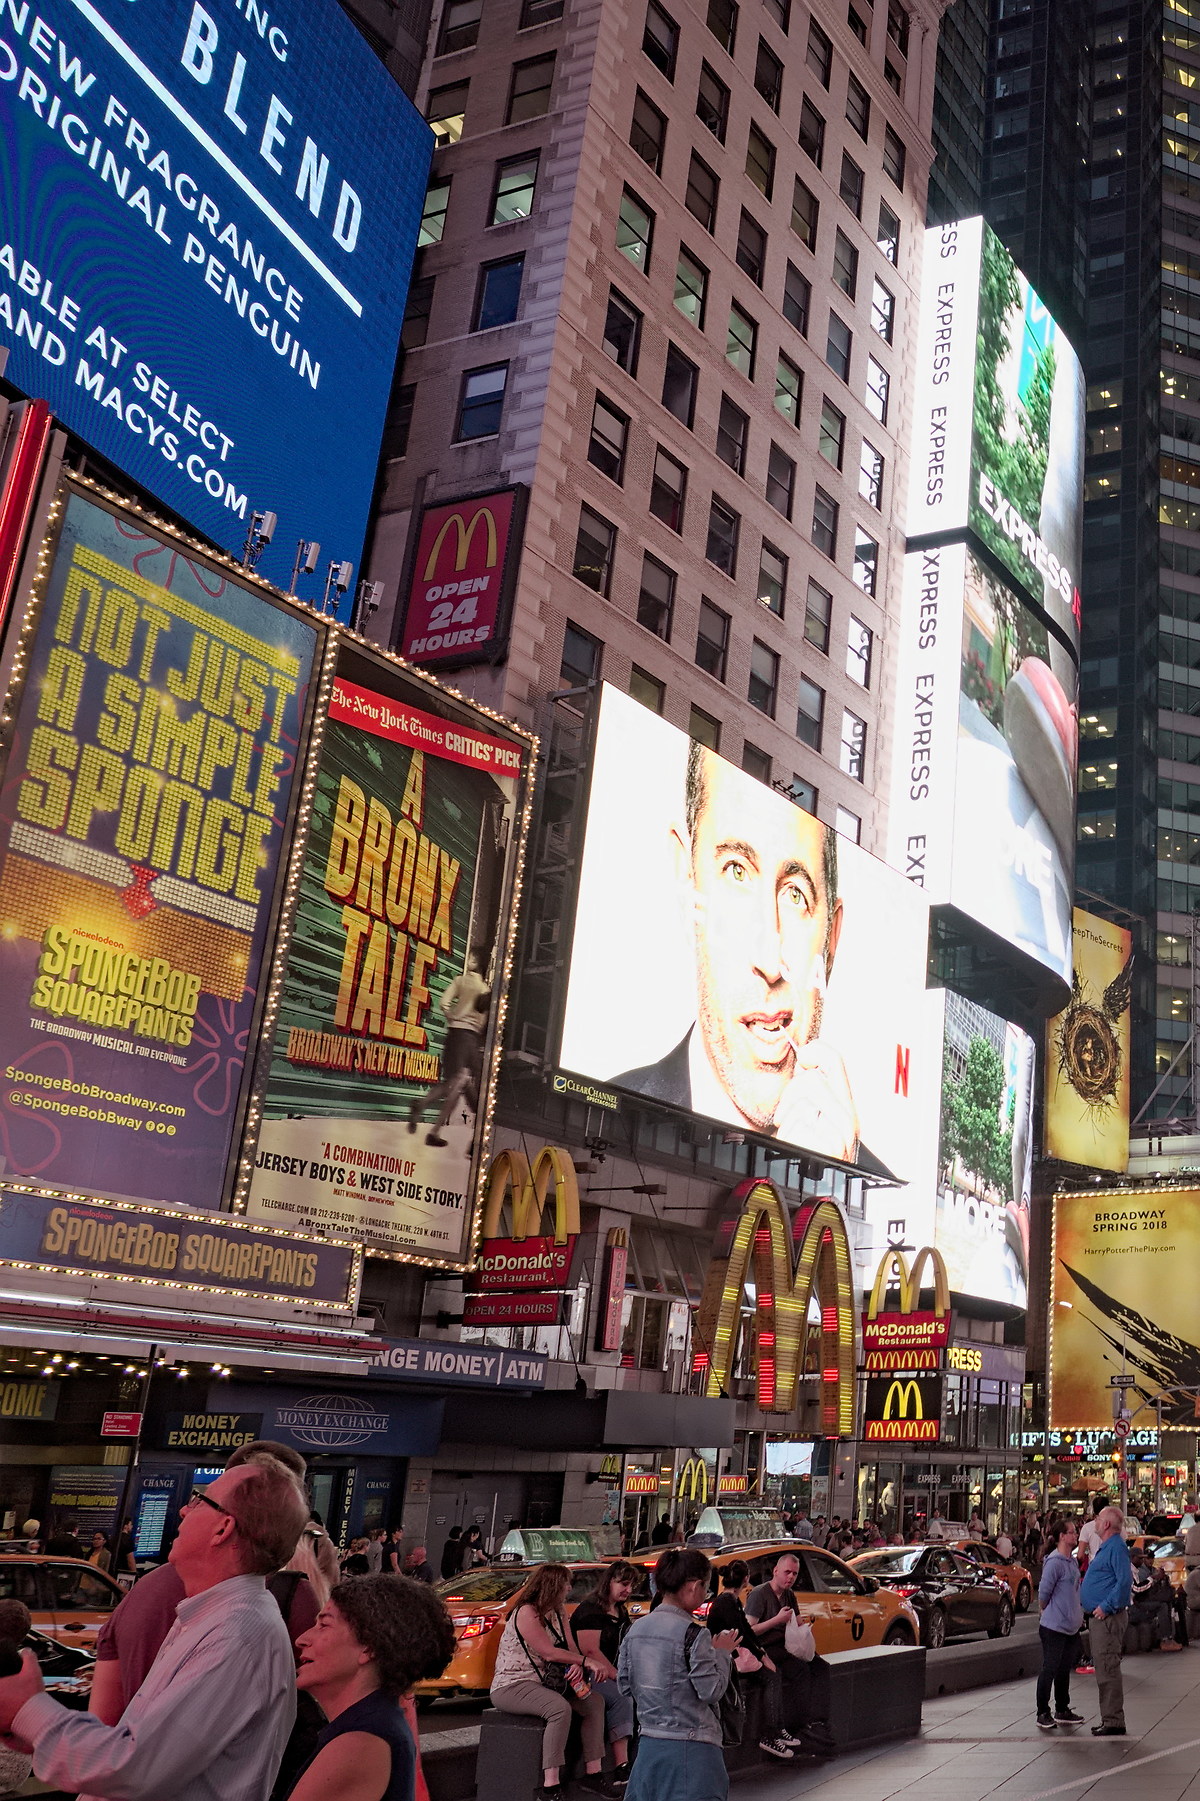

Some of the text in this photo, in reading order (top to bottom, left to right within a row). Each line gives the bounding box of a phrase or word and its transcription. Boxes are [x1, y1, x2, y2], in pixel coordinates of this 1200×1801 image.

[181, 0, 362, 253] BLEND
[0, 0, 304, 323] NEW FRAGRANCE
[0, 40, 322, 390] ORIGINAL PENGUIN
[932, 281, 955, 386] EXPRESS
[0, 293, 249, 520] AND MACYS.COM
[85, 325, 128, 367] AT
[132, 361, 235, 462] SELECT
[926, 405, 948, 507] EXPRESS
[978, 471, 1073, 604] EXPRESS
[425, 575, 490, 602] OPEN
[919, 548, 940, 651] XPRESS
[427, 596, 479, 631] 24
[54, 566, 297, 744] NOT JUST
[409, 625, 490, 655] HOURS
[37, 645, 285, 818] A SIMPLE
[330, 686, 353, 710] The
[353, 694, 380, 721] New
[379, 705, 410, 732] York
[411, 717, 444, 745] Times
[495, 746, 521, 769] PICK
[909, 673, 935, 802] EXPRESS
[401, 748, 426, 830] A
[17, 724, 273, 901] SPONGE
[324, 773, 462, 952] BRONX
[72, 927, 124, 949] nickelodeon
[41, 924, 202, 1018] SPONGEBOB
[333, 904, 437, 1047] TALE
[30, 975, 195, 1048] SQUAREPANTS
[30, 1018, 187, 1067] THE BROADWAY MUSICAL FOR EVERYONE
[286, 1027, 439, 1081] BROADWAY'S NEW HIT MUSICAL
[5, 1066, 186, 1118] SpongeBobBroadway.com
[9, 1090, 143, 1131] @SpongeBobBway
[255, 1151, 309, 1177] JERSEY
[309, 1163, 345, 1185] BOYS
[346, 1170, 357, 1187] &
[360, 1173, 395, 1196] WEST
[396, 1180, 423, 1201] SIDE
[333, 1145, 401, 1175] COMBINATION
[403, 1161, 416, 1178] OF
[261, 1198, 309, 1216] TELECHARGE.COM
[310, 1206, 318, 1216] OR
[1093, 1221, 1167, 1232] SPRING 2018
[1095, 1210, 1166, 1221] BROADWAY
[43, 1207, 318, 1288] SPONGEBOB SQUAREPANTS
[298, 1218, 416, 1245] ABronxTaleTheMusical.com
[1085, 1245, 1176, 1256] HarryPotterThePlay.com
[476, 1253, 567, 1272] McDonald's
[481, 1272, 547, 1283] Restaurant
[465, 1304, 553, 1316] OPEN 24 HOURS
[865, 1321, 945, 1338] McDonald's
[878, 1335, 931, 1346] Restaurant
[424, 1352, 500, 1377] MONEY
[505, 1361, 544, 1382] ATM
[0, 1382, 46, 1417] OME
[182, 1414, 241, 1430] MONEY
[278, 1411, 389, 1430] MONEY EXCHANGE
[168, 1431, 255, 1447] EXCHANGE
[143, 1478, 175, 1488] CHANGE
[343, 1468, 356, 1514] MONEY
[366, 1481, 390, 1489] CHANGE
[918, 1474, 941, 1484] EXPRESS
